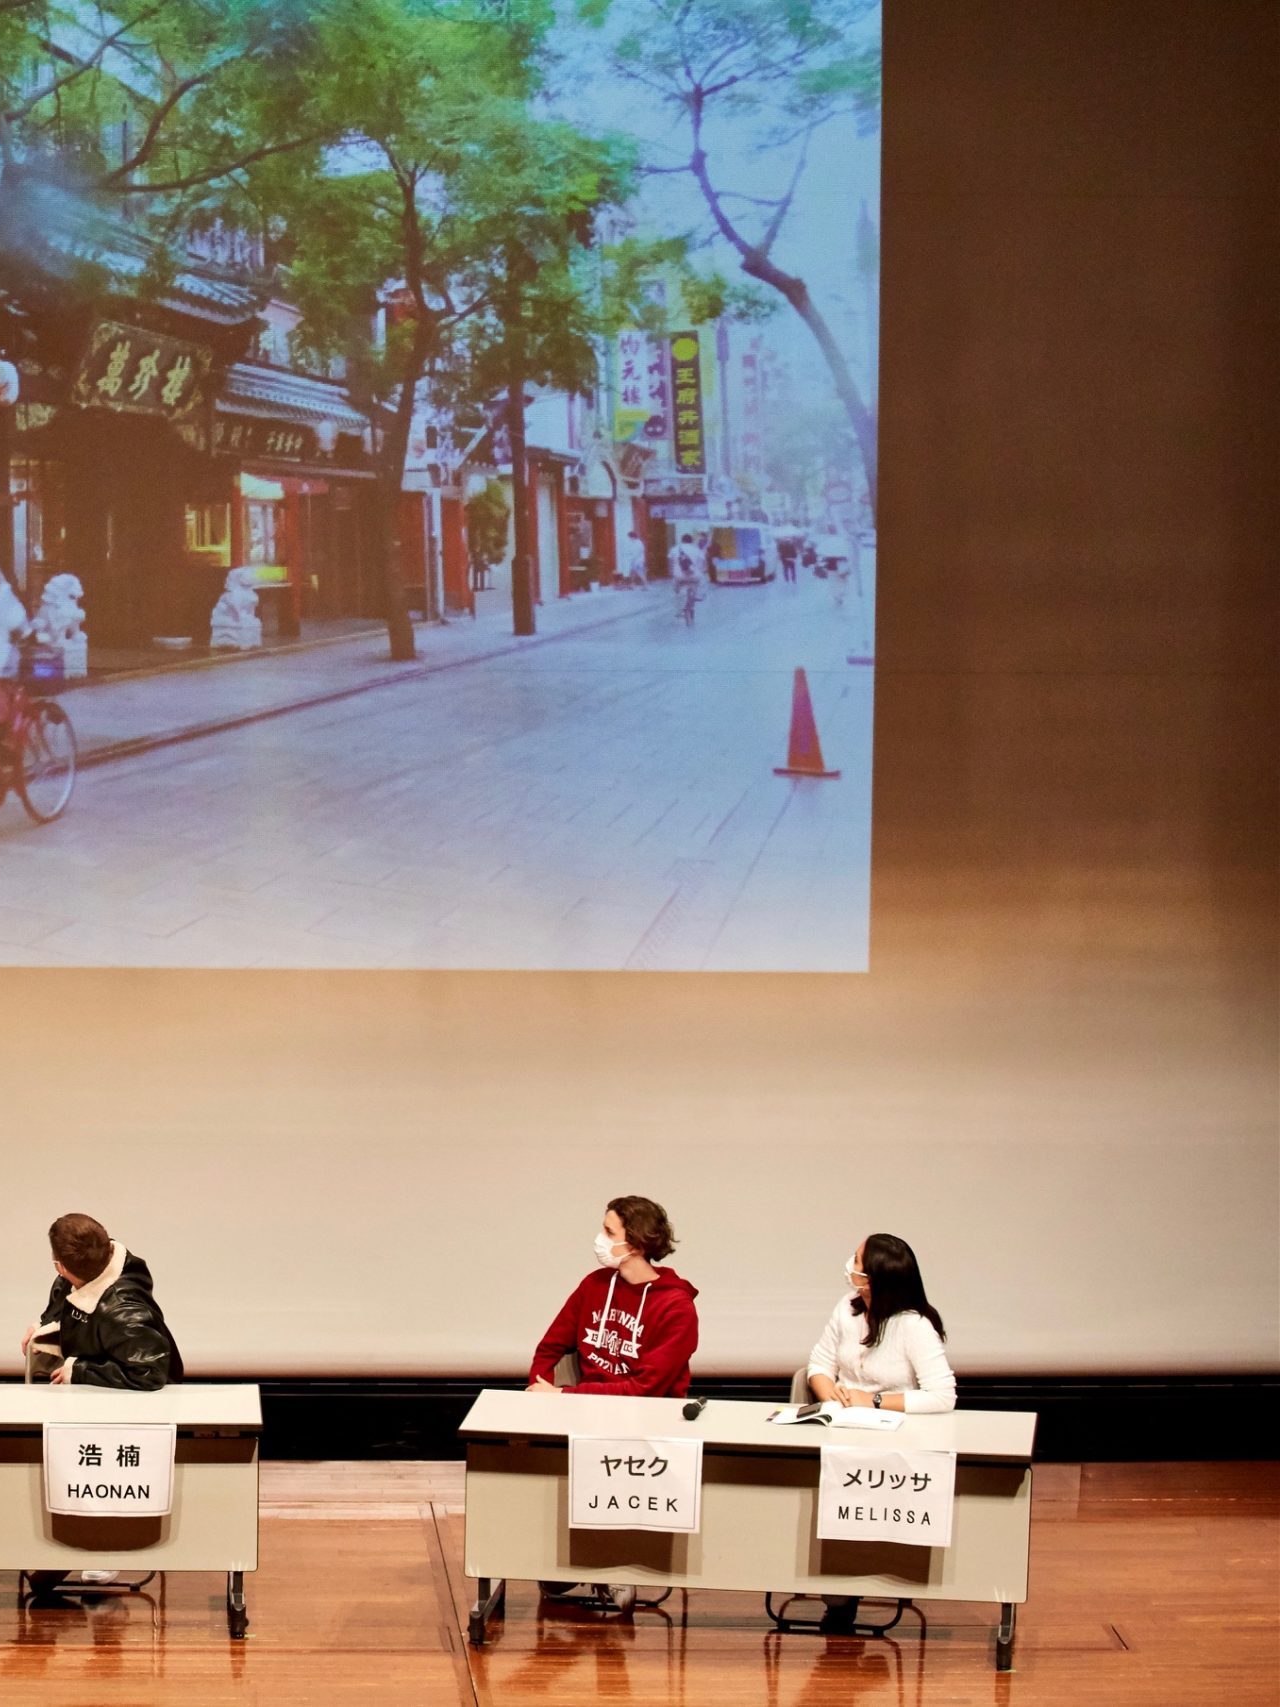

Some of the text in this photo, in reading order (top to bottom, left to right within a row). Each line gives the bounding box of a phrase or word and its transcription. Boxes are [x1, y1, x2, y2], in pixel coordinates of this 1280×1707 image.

[78, 1443, 141, 1468] 浩楠
[600, 1455, 669, 1478] ヤセク
[843, 1468, 932, 1492] メリッサ
[67, 1483, 150, 1500] HAONAN
[589, 1495, 679, 1513] JACEK
[838, 1506, 931, 1526] MELISSA
